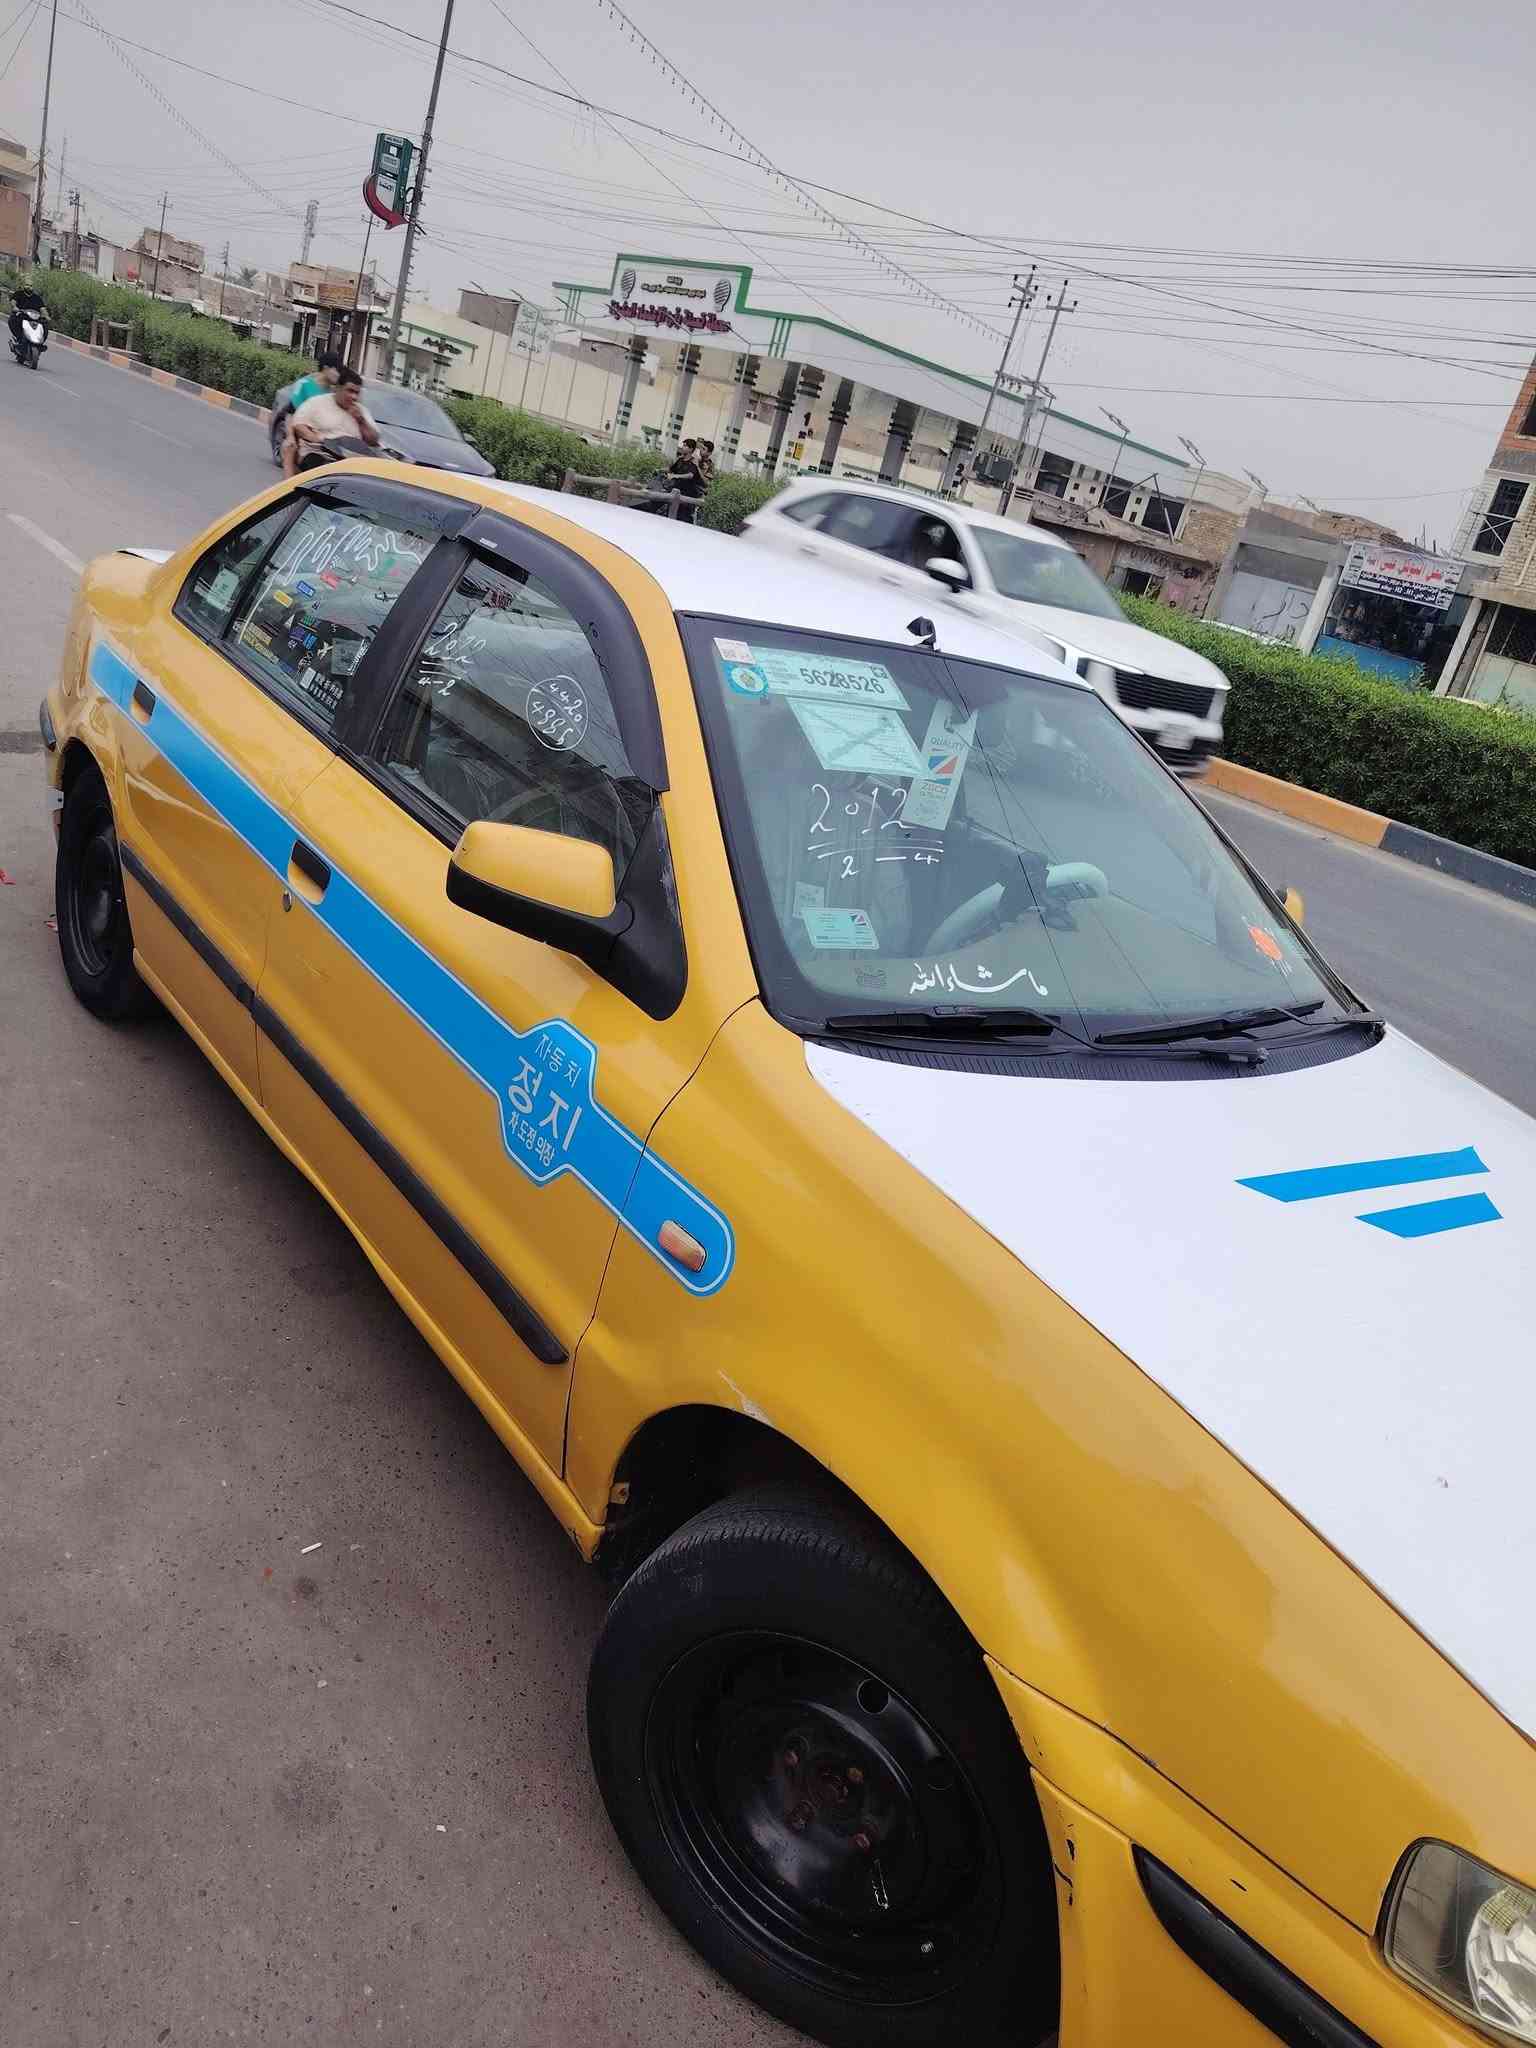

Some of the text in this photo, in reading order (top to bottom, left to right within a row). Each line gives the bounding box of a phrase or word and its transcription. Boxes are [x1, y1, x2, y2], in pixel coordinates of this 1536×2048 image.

[799, 667, 886, 696] 5628526
[808, 784, 913, 834] 2012
[508, 1055, 584, 1152] 정지
